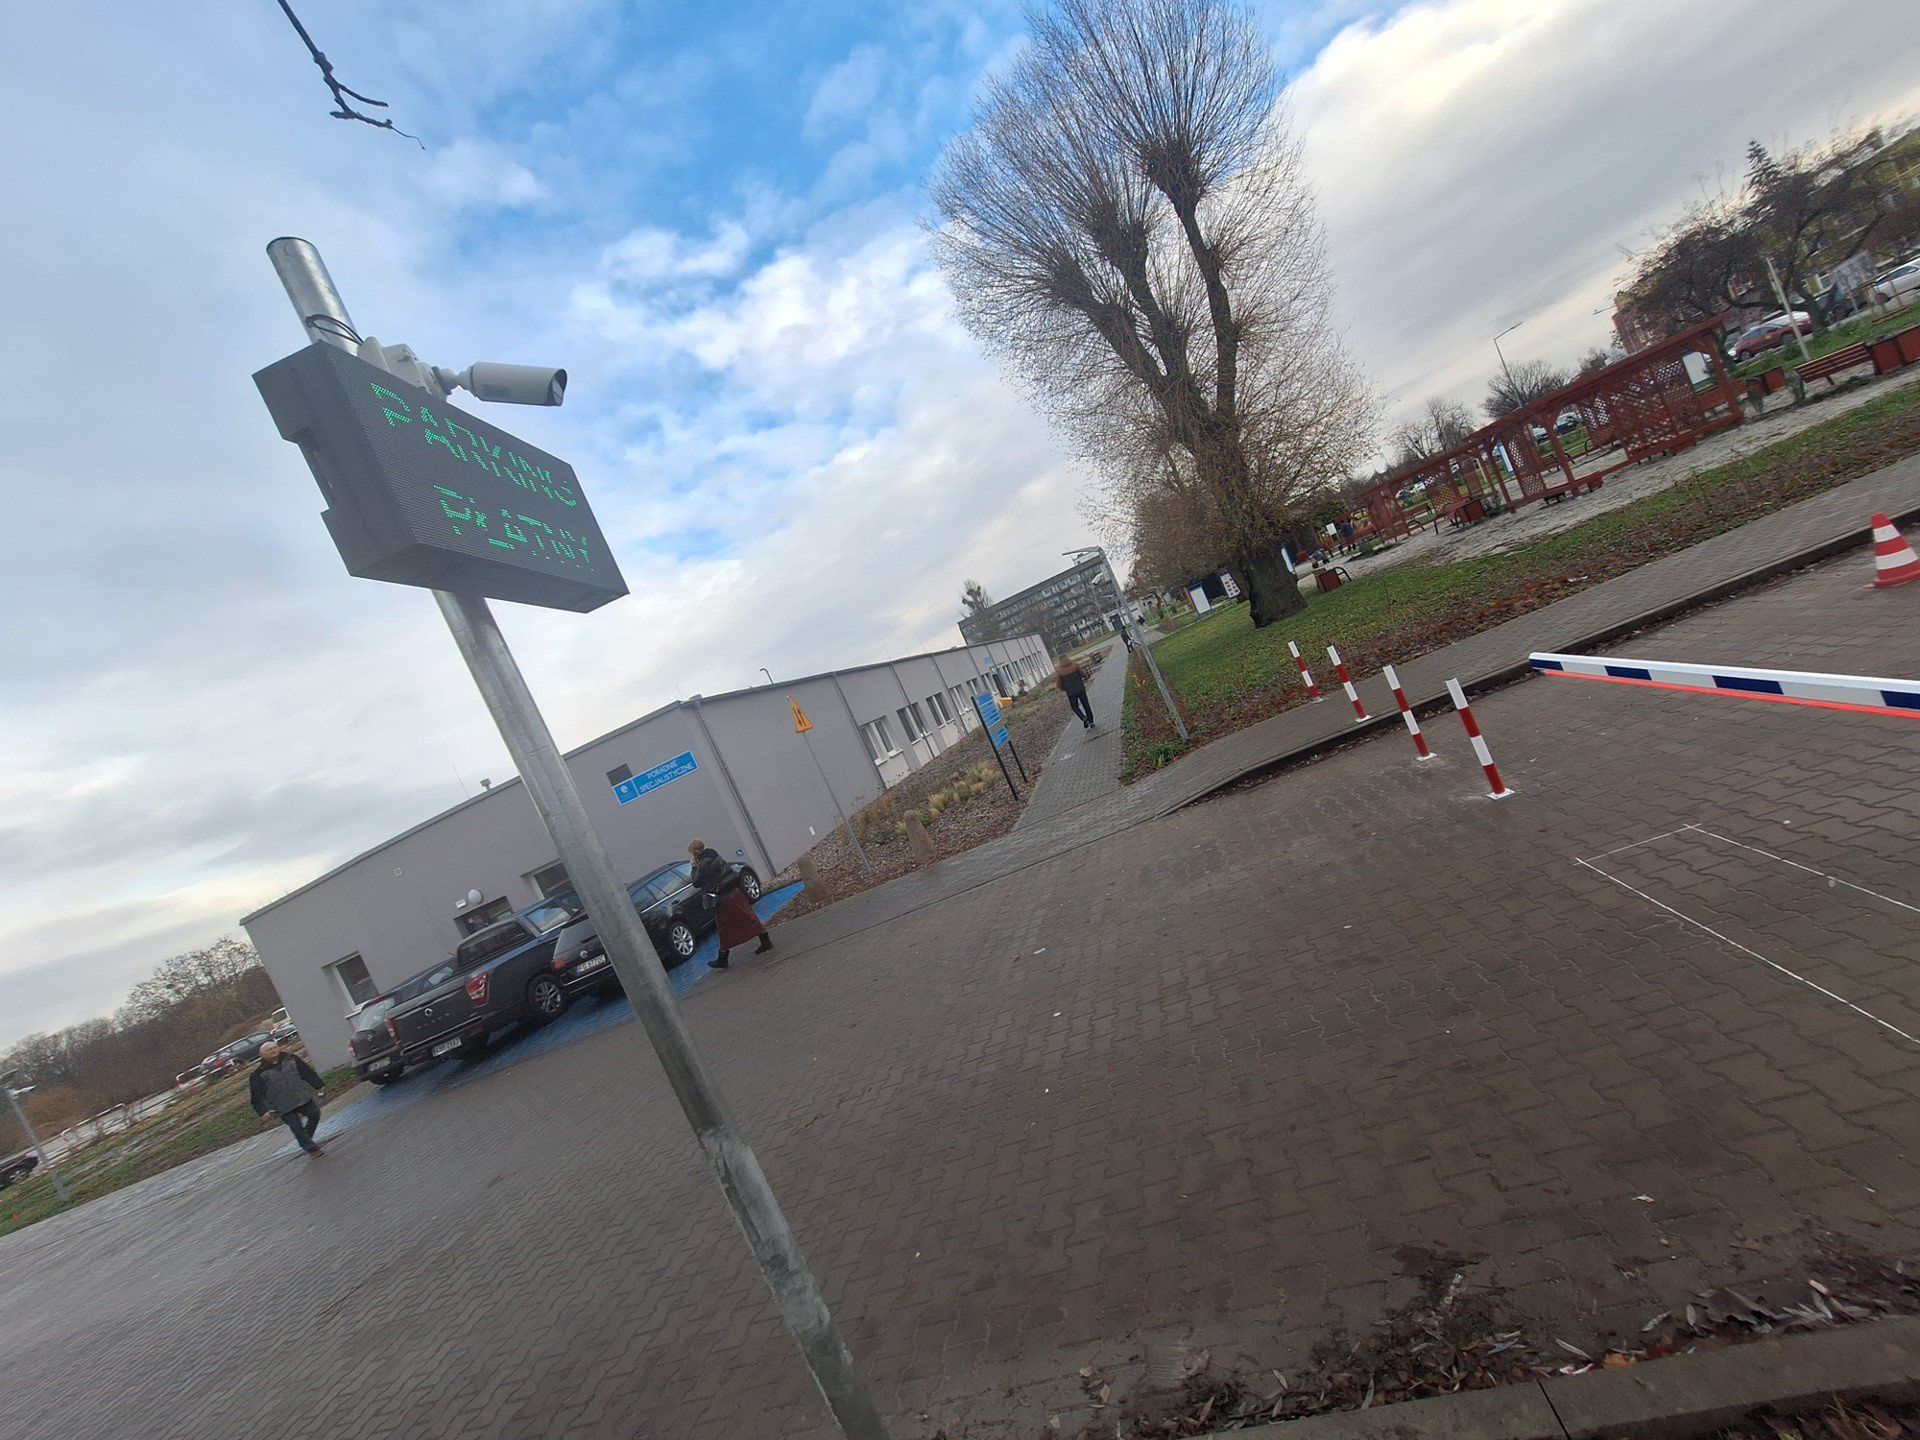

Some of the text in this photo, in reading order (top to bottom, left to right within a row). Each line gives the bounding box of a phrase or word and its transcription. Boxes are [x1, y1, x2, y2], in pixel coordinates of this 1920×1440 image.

[371, 382, 576, 507] PARKING
[638, 762, 694, 793] SPECJALISTYCZNE
[646, 759, 679, 779] PORADNIE
